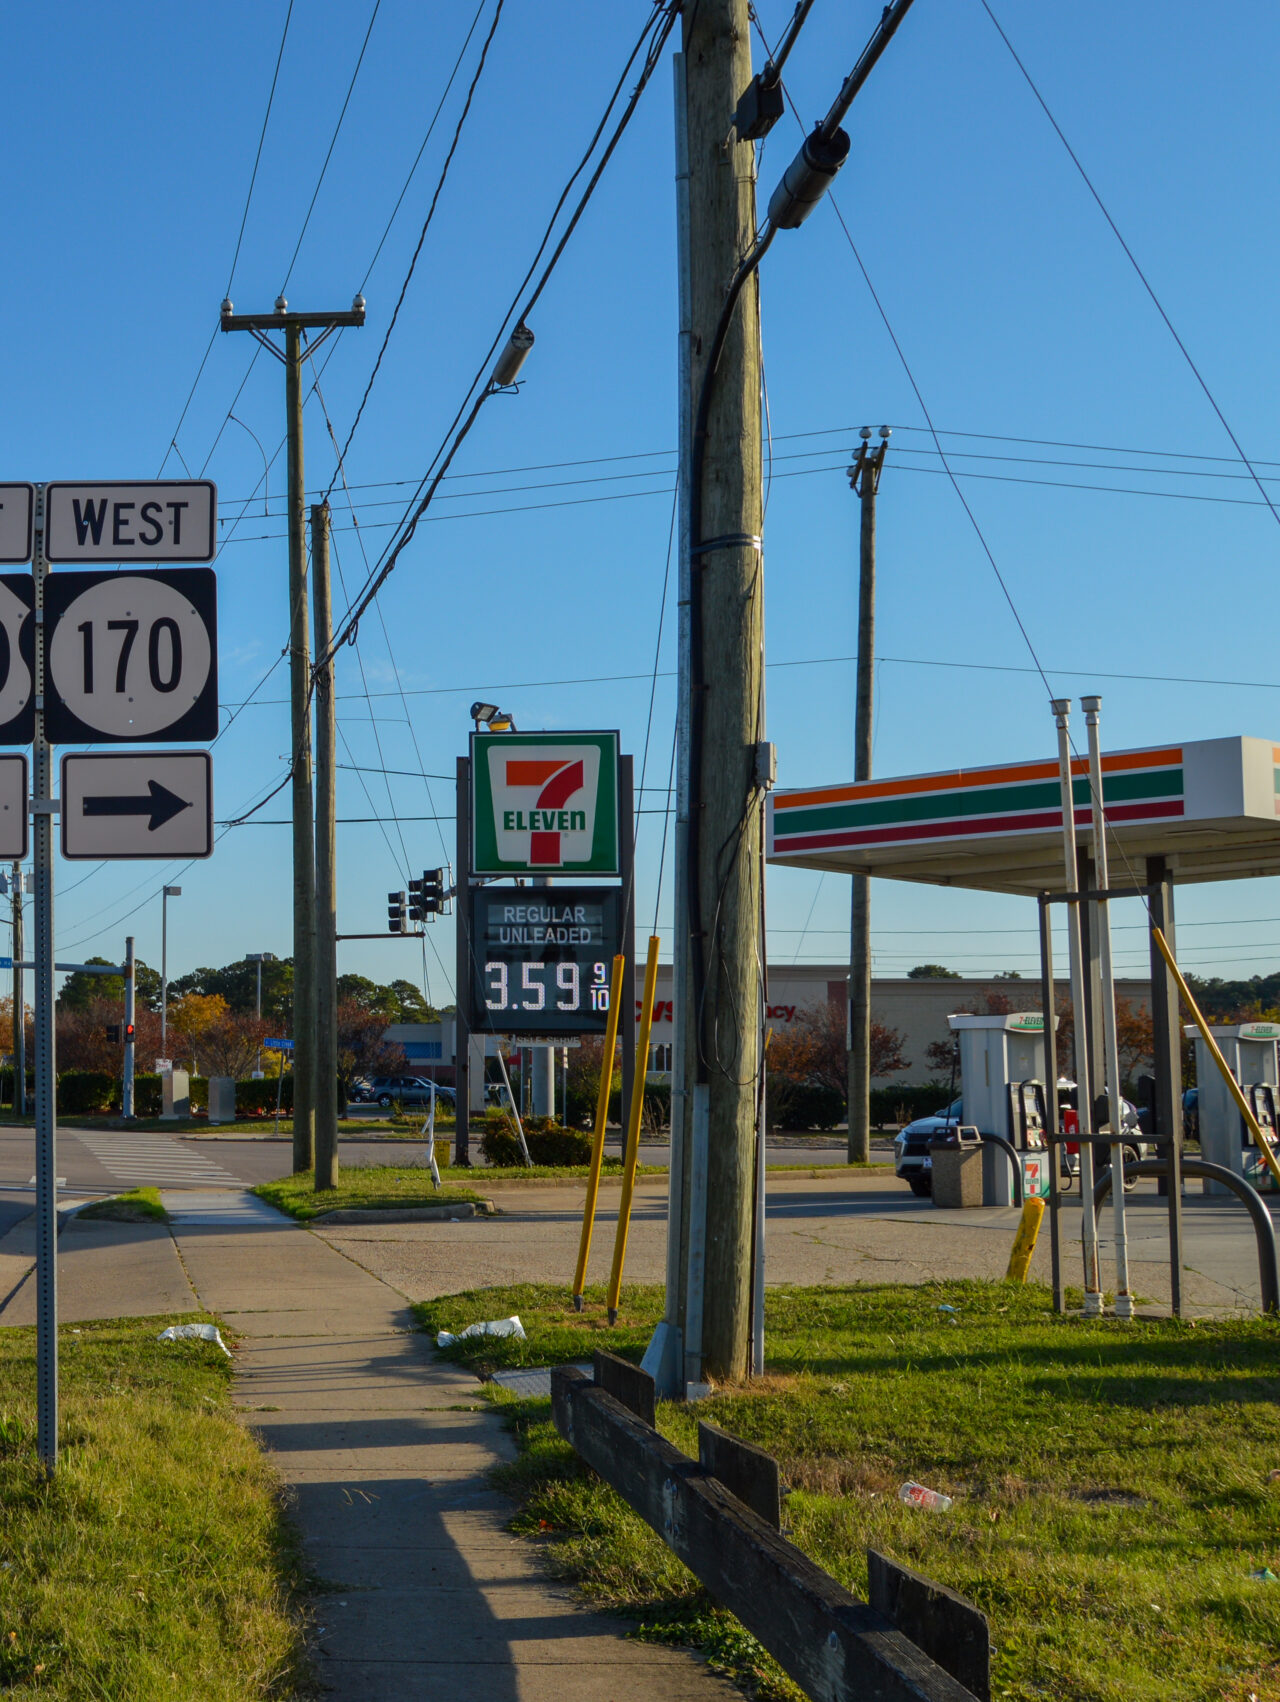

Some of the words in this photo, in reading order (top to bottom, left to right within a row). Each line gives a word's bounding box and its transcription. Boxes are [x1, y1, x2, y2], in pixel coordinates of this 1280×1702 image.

[72, 498, 190, 546] WEST
[77, 616, 183, 694] 170
[505, 759, 584, 865] 7
[499, 927, 592, 944] UNLEADED
[503, 906, 586, 923] REGULAR
[485, 962, 580, 1011] 3.59
